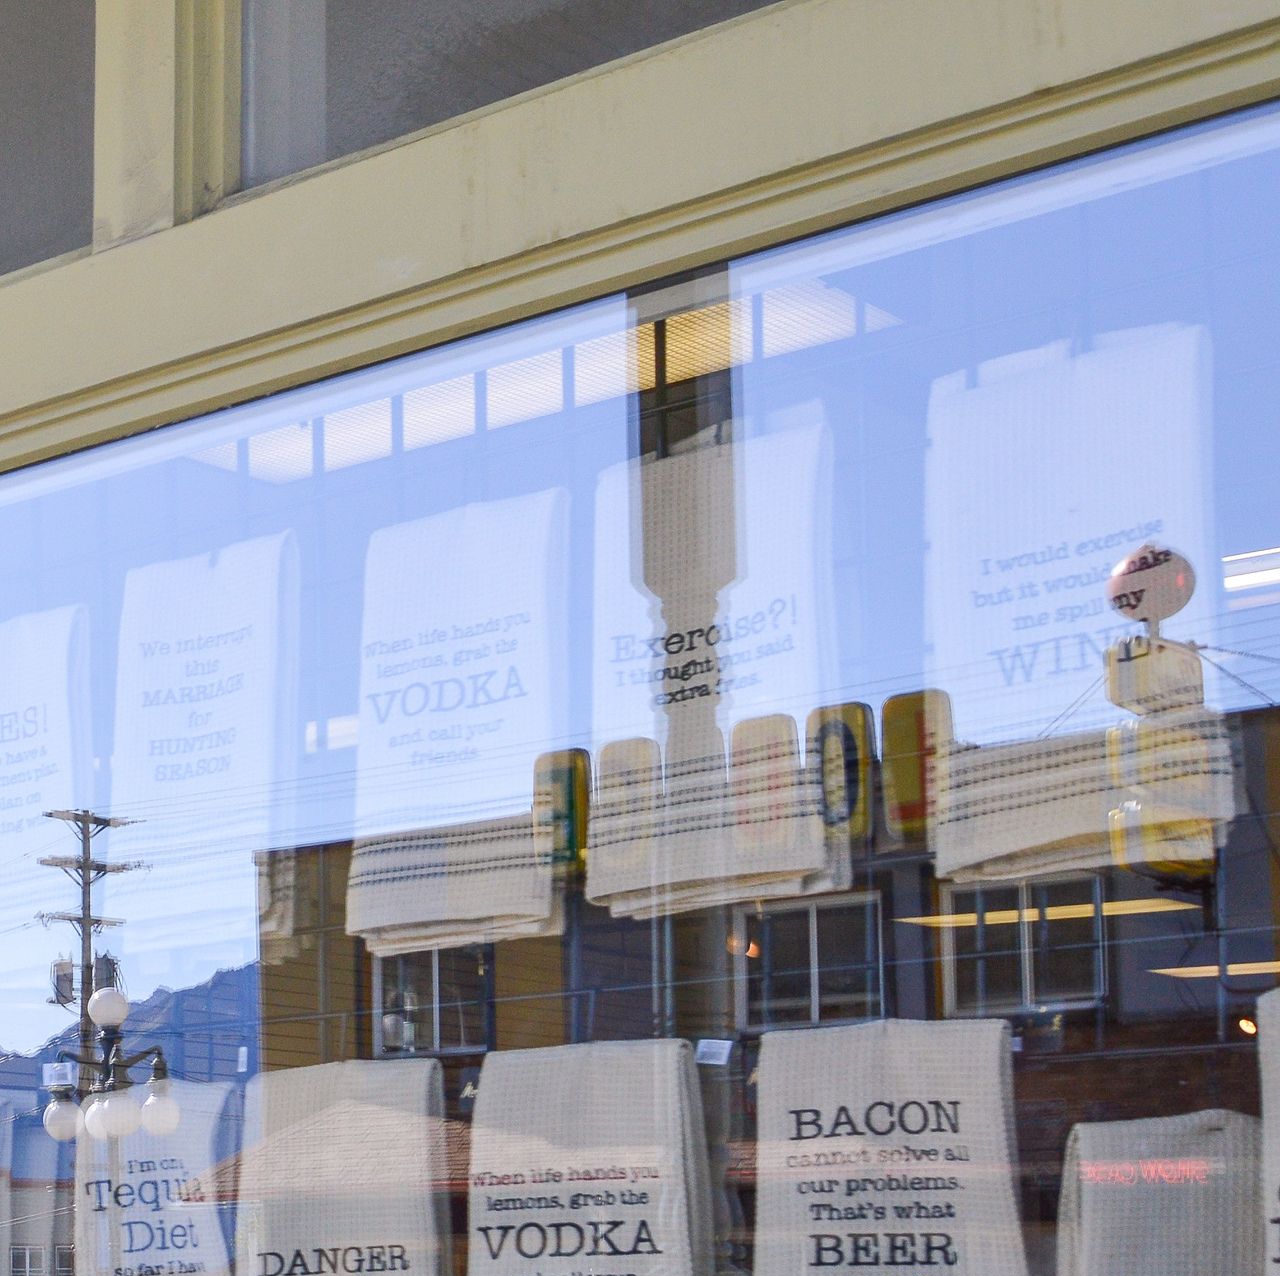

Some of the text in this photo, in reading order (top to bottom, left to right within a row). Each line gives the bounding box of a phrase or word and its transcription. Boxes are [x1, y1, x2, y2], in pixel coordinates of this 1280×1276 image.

[979, 518, 1163, 575] I would exercise
[971, 562, 1111, 608] but it would
[1012, 586, 1146, 631] me spill my
[364, 612, 531, 658] When life hands you
[610, 593, 798, 663] Exercise?!
[139, 641, 171, 658] We
[452, 638, 519, 666] grab the
[184, 659, 220, 677] this
[629, 657, 715, 687] thought
[142, 673, 245, 707] MARRIAGE
[366, 665, 528, 724] VODKA
[656, 683, 710, 705] extra
[188, 711, 213, 728] for
[389, 718, 504, 748] and call your
[148, 727, 237, 756] HUNTING
[5, 749, 38, 766] have
[154, 755, 231, 782] SEASON
[26, 792, 41, 804] on
[789, 1100, 961, 1141] BACON
[128, 1159, 156, 1174] I'm
[787, 1145, 970, 1168] cannot solve all
[474, 1165, 660, 1187] When life hands you
[796, 1175, 965, 1196] our problems.
[486, 1190, 650, 1212] lemons, grab the
[809, 1201, 956, 1221] That's what
[122, 1217, 199, 1253] Diet
[477, 1219, 663, 1260] VODKA
[809, 1232, 958, 1267] BEER
[138, 1263, 164, 1276] far
[168, 1261, 176, 1274] I
